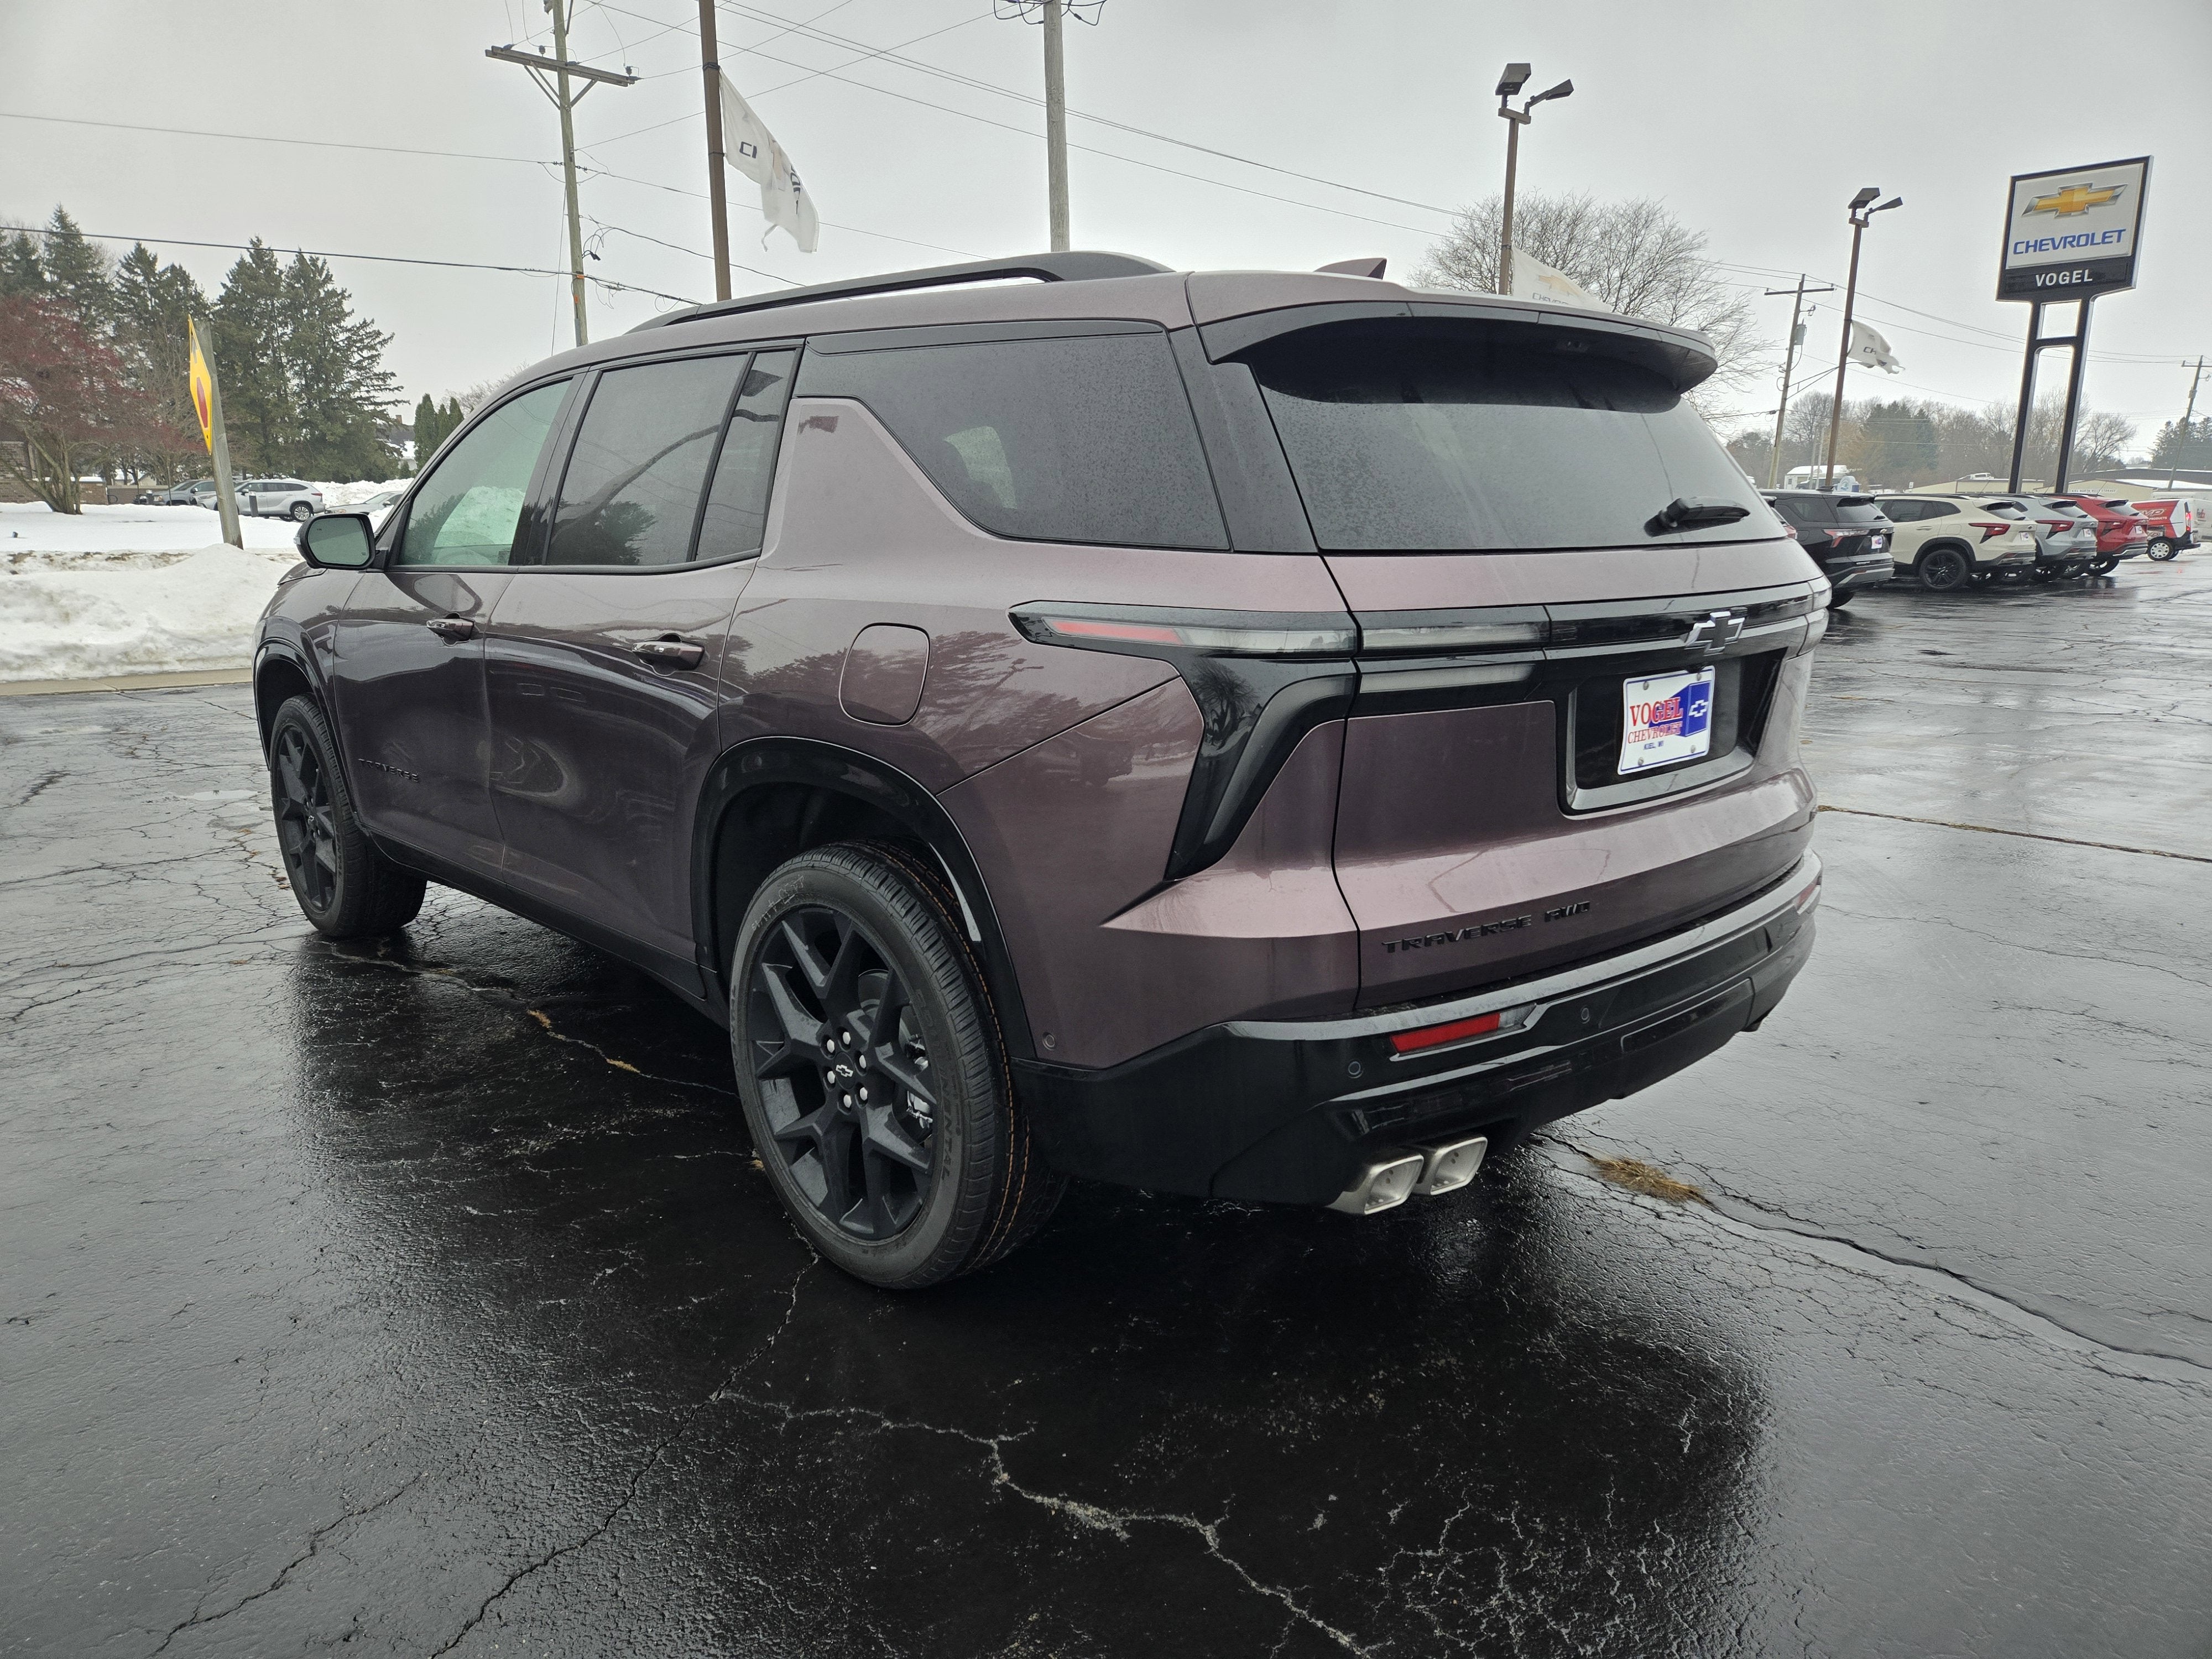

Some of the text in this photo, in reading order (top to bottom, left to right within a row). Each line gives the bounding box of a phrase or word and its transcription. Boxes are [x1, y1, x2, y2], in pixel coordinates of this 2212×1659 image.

[2013, 228, 2126, 255] CHEVROLET
[2035, 269, 2093, 286] VOGEL
[1630, 697, 1683, 727] VOGEL
[1627, 721, 1683, 744] CHEVROLET
[358, 758, 420, 782] TRAVERSE
[1381, 901, 1590, 953] TRAVERSE AWD
